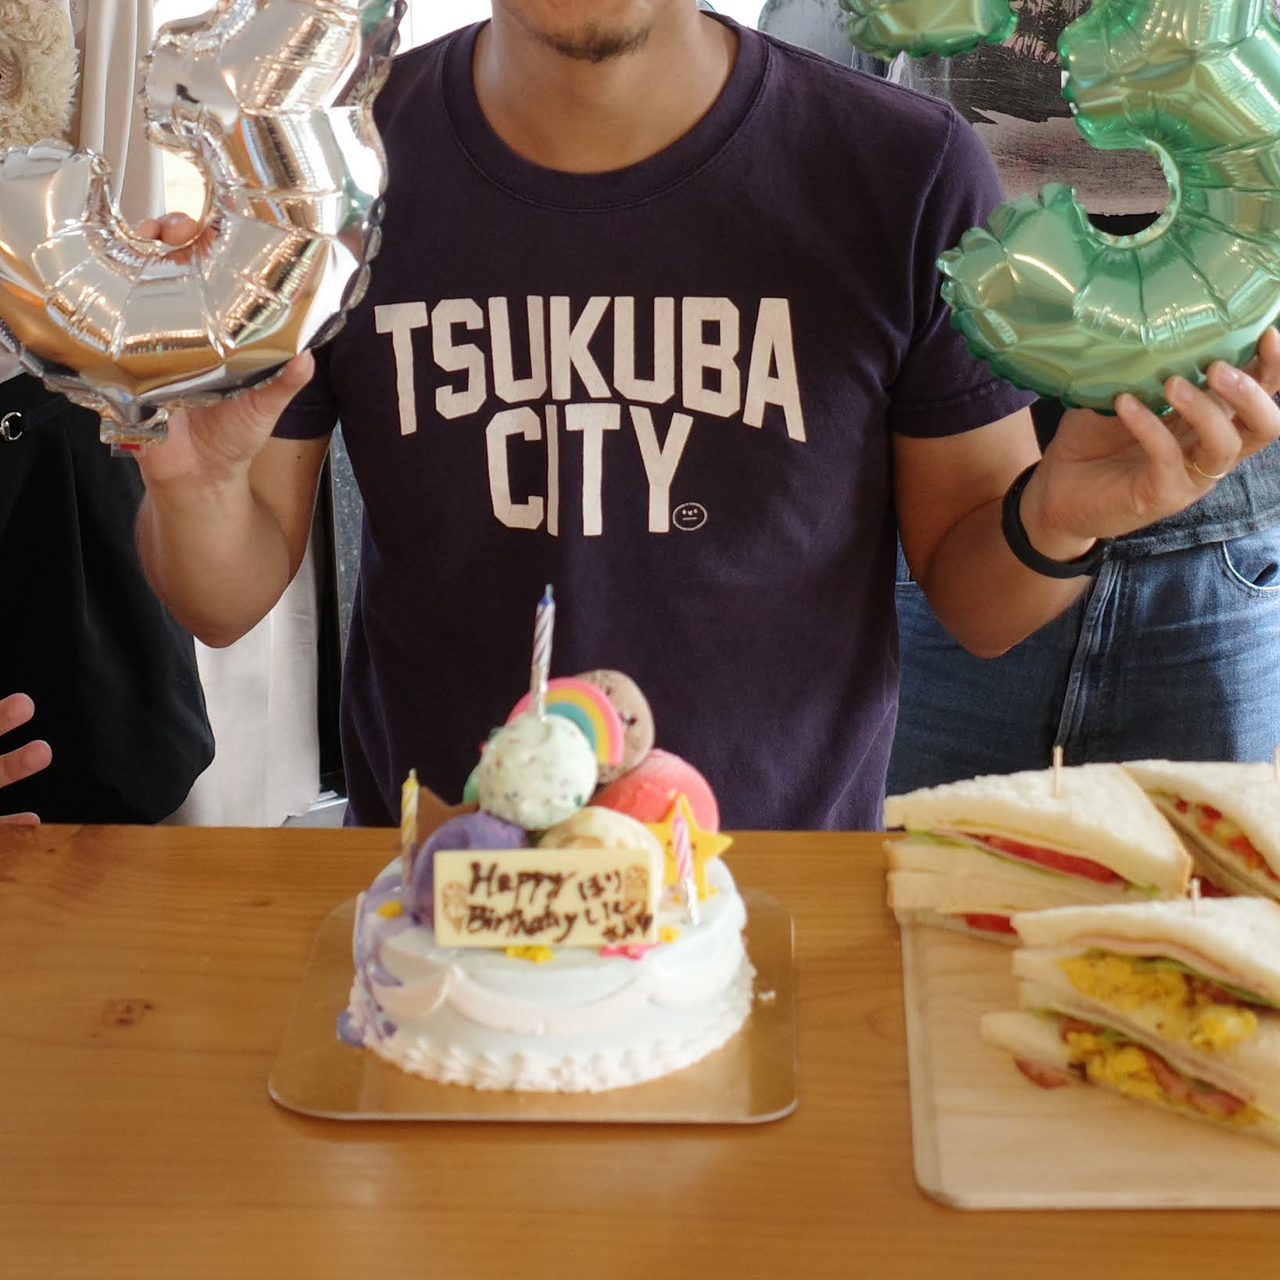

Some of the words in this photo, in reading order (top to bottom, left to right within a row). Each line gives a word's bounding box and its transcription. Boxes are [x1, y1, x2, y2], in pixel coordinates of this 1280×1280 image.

[374, 295, 807, 442] TSUKUBA
[486, 403, 694, 537] CITY
[466, 902, 577, 945] Birthday
[469, 860, 577, 909] Happy
